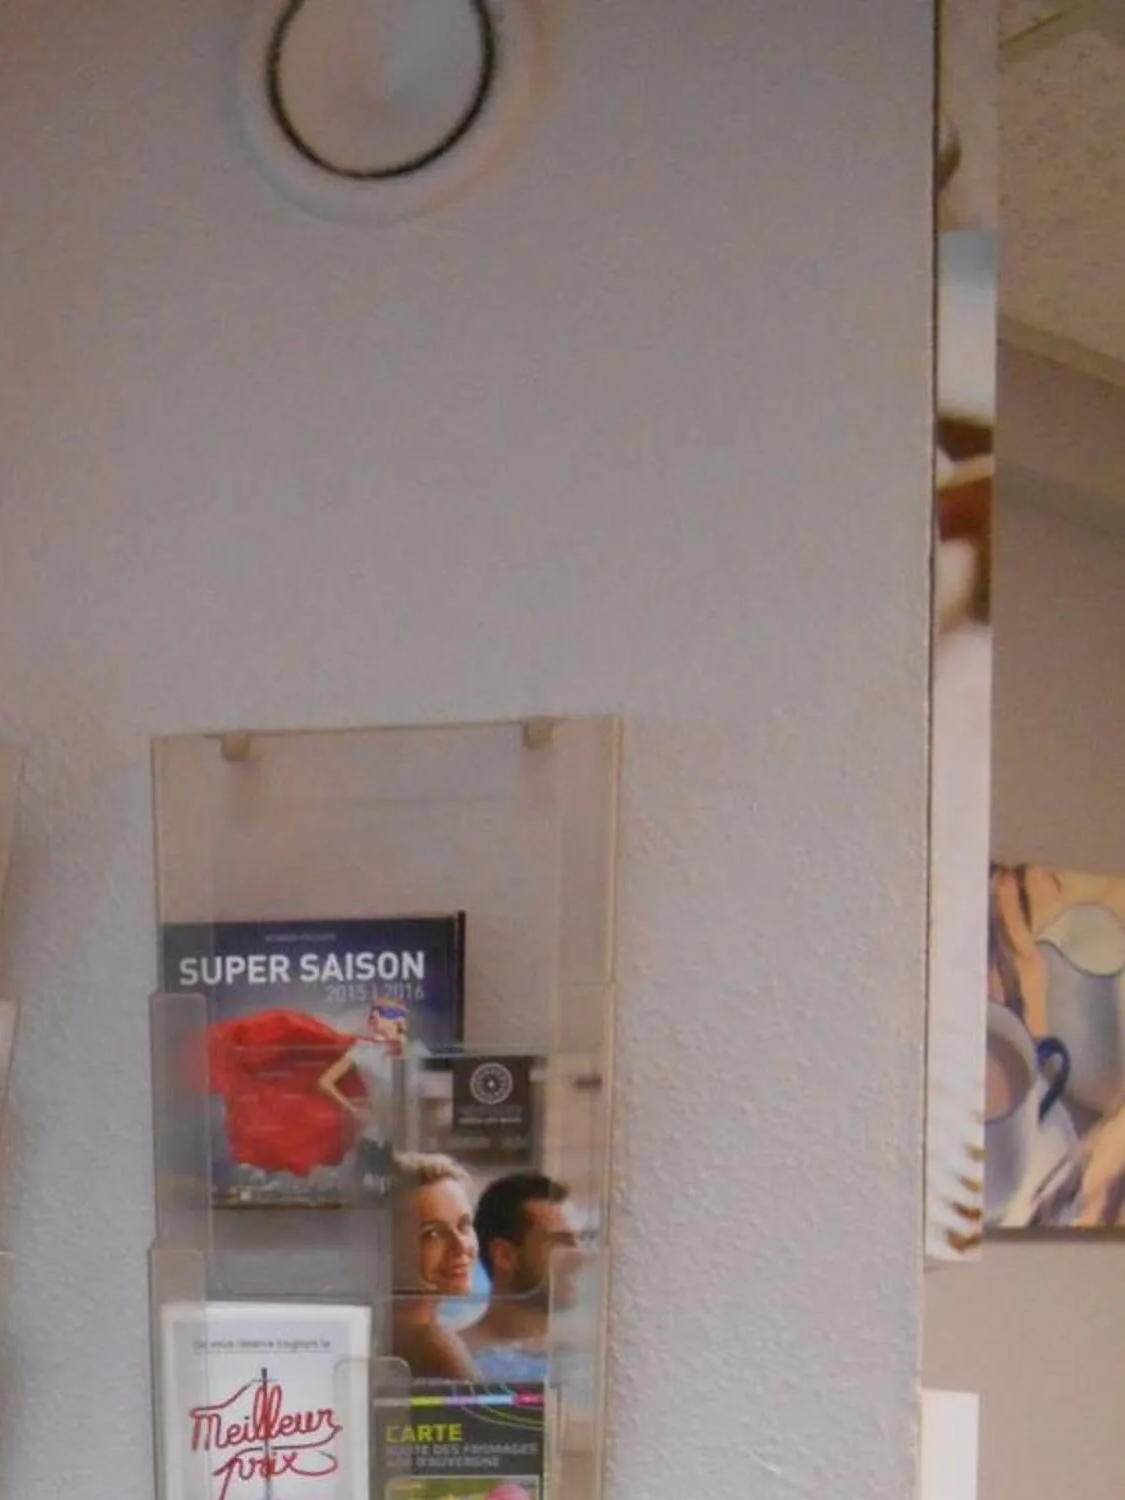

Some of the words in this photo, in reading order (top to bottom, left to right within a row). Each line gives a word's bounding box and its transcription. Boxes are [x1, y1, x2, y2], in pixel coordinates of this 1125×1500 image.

[178, 953, 291, 987] SUPER
[299, 951, 426, 983] SAISON
[189, 1384, 344, 1452] Meilleur
[384, 1423, 464, 1443] CARTE
